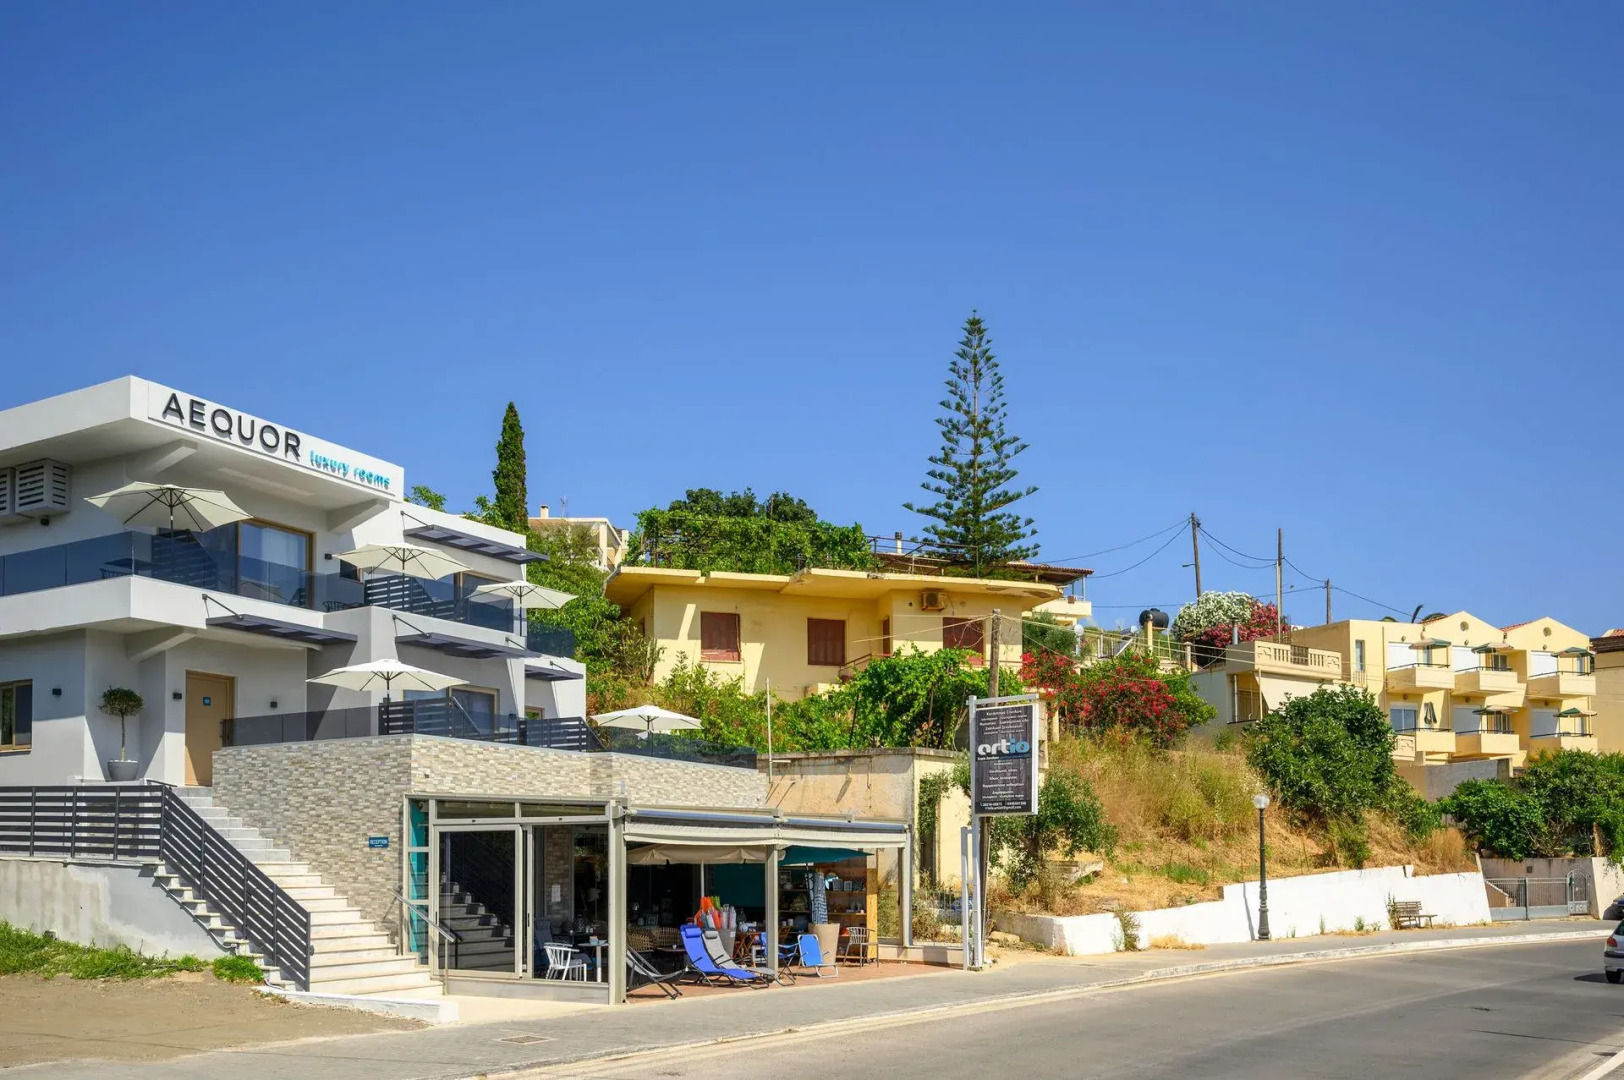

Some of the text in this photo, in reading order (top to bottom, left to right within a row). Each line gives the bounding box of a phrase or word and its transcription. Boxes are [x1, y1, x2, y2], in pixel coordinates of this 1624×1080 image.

[162, 392, 391, 489] AEQUOR luxury rooms
[977, 738, 1030, 755] artio
